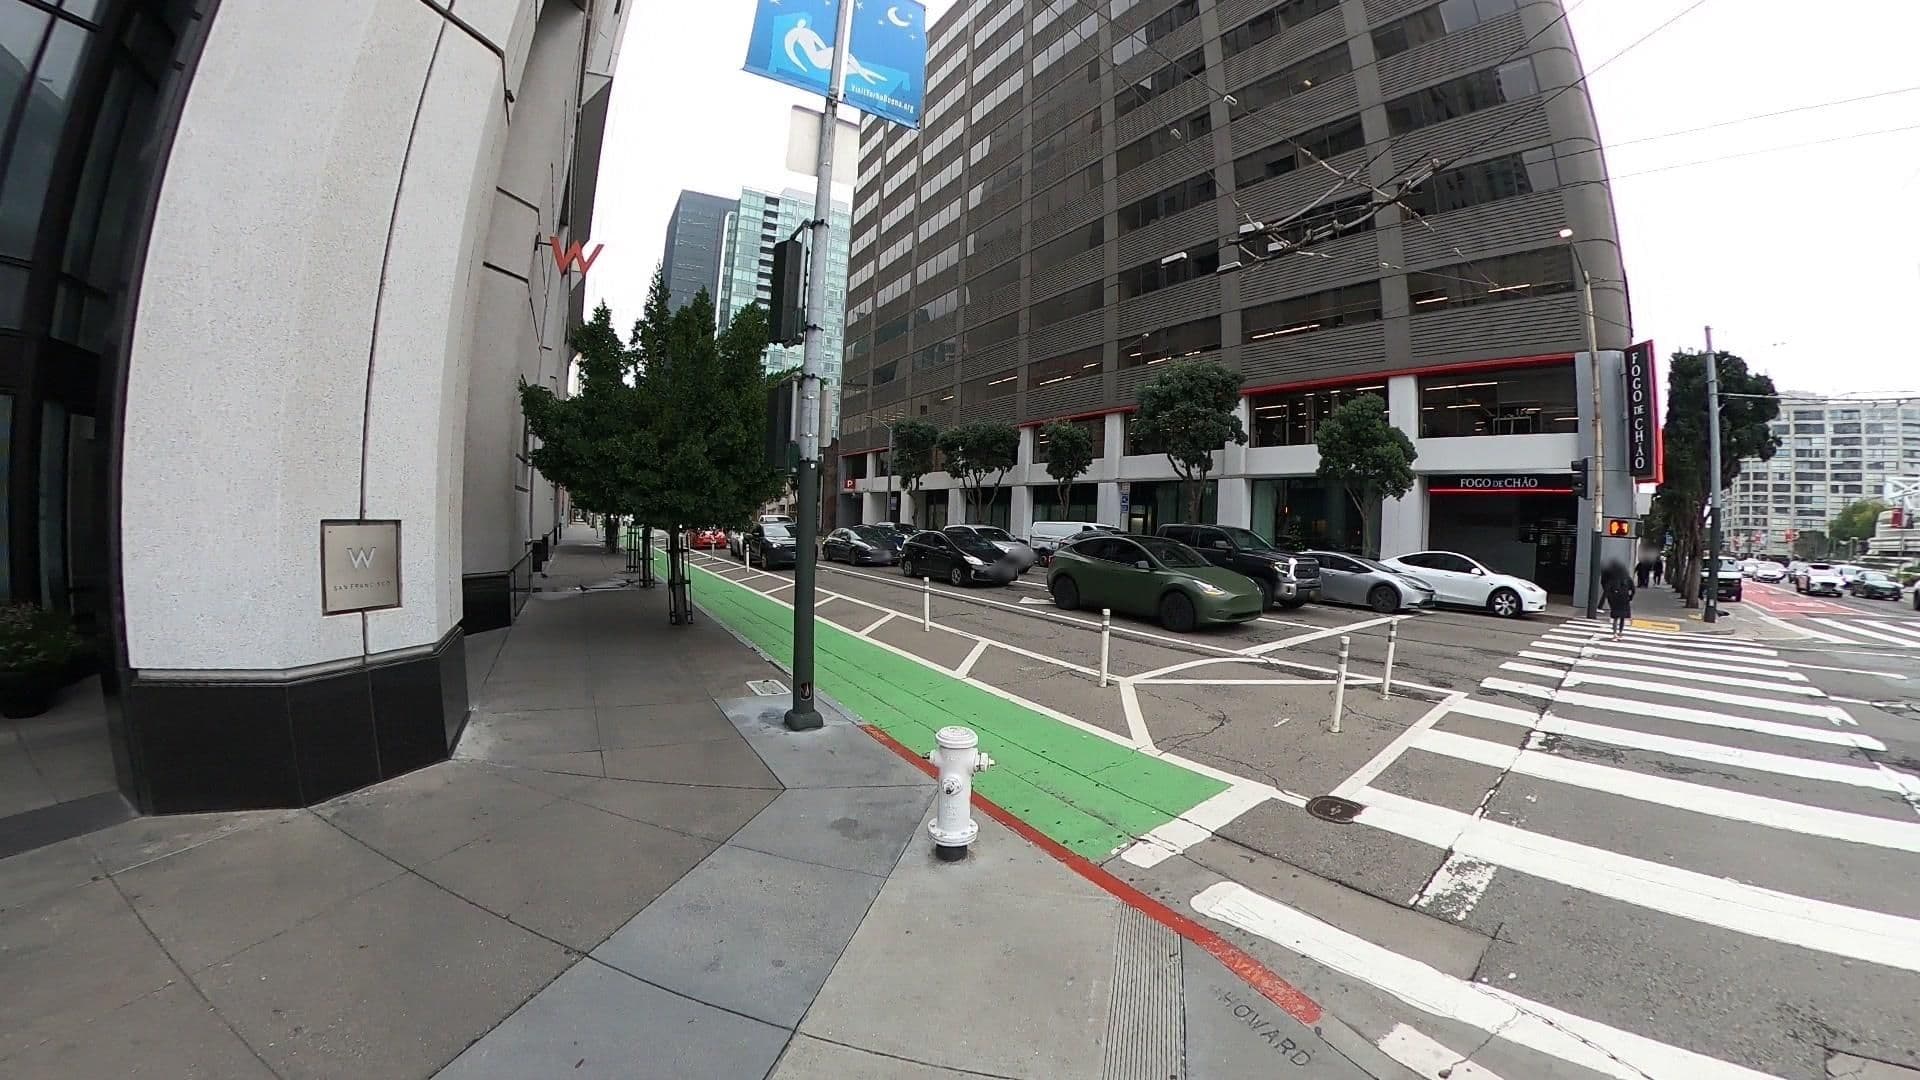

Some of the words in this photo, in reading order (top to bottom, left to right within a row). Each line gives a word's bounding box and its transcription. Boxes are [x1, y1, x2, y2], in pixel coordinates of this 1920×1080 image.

[549, 236, 605, 277] W
[1631, 352, 1642, 402] FOGO
[1633, 405, 1645, 415] DE
[847, 480, 853, 488] P
[1460, 478, 1491, 488] FOGO
[1504, 476, 1538, 488] CHÃO
[346, 546, 377, 569] W
[1223, 991, 1312, 1066] HOWARD
